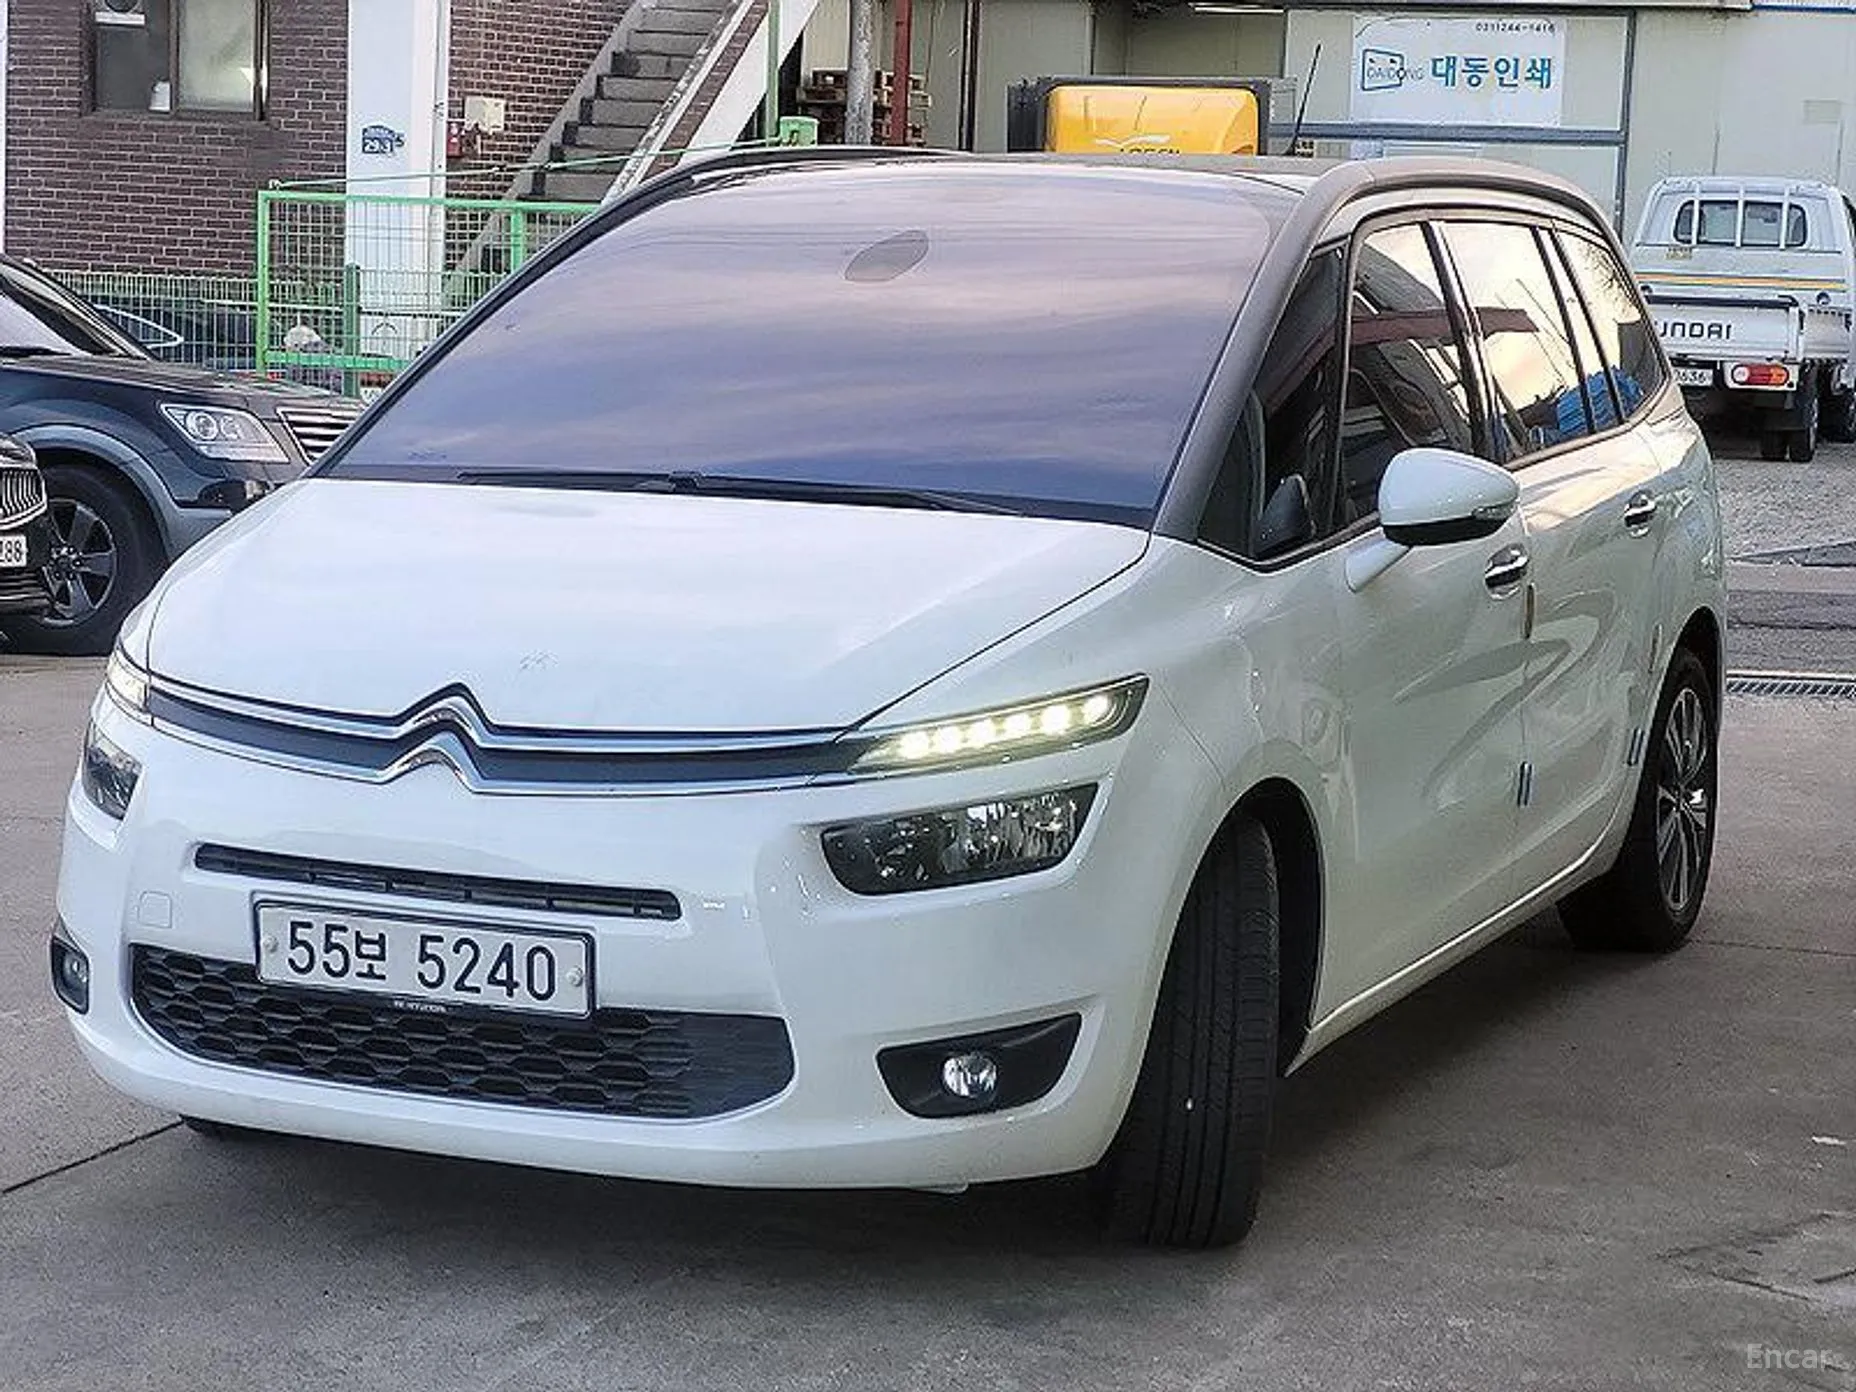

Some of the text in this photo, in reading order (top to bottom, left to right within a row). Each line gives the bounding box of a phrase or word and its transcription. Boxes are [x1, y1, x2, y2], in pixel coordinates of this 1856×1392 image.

[1430, 55, 1552, 89] 대동인쇄
[1653, 321, 1732, 340] UNDAI
[287, 920, 556, 1002] 55보 5240
